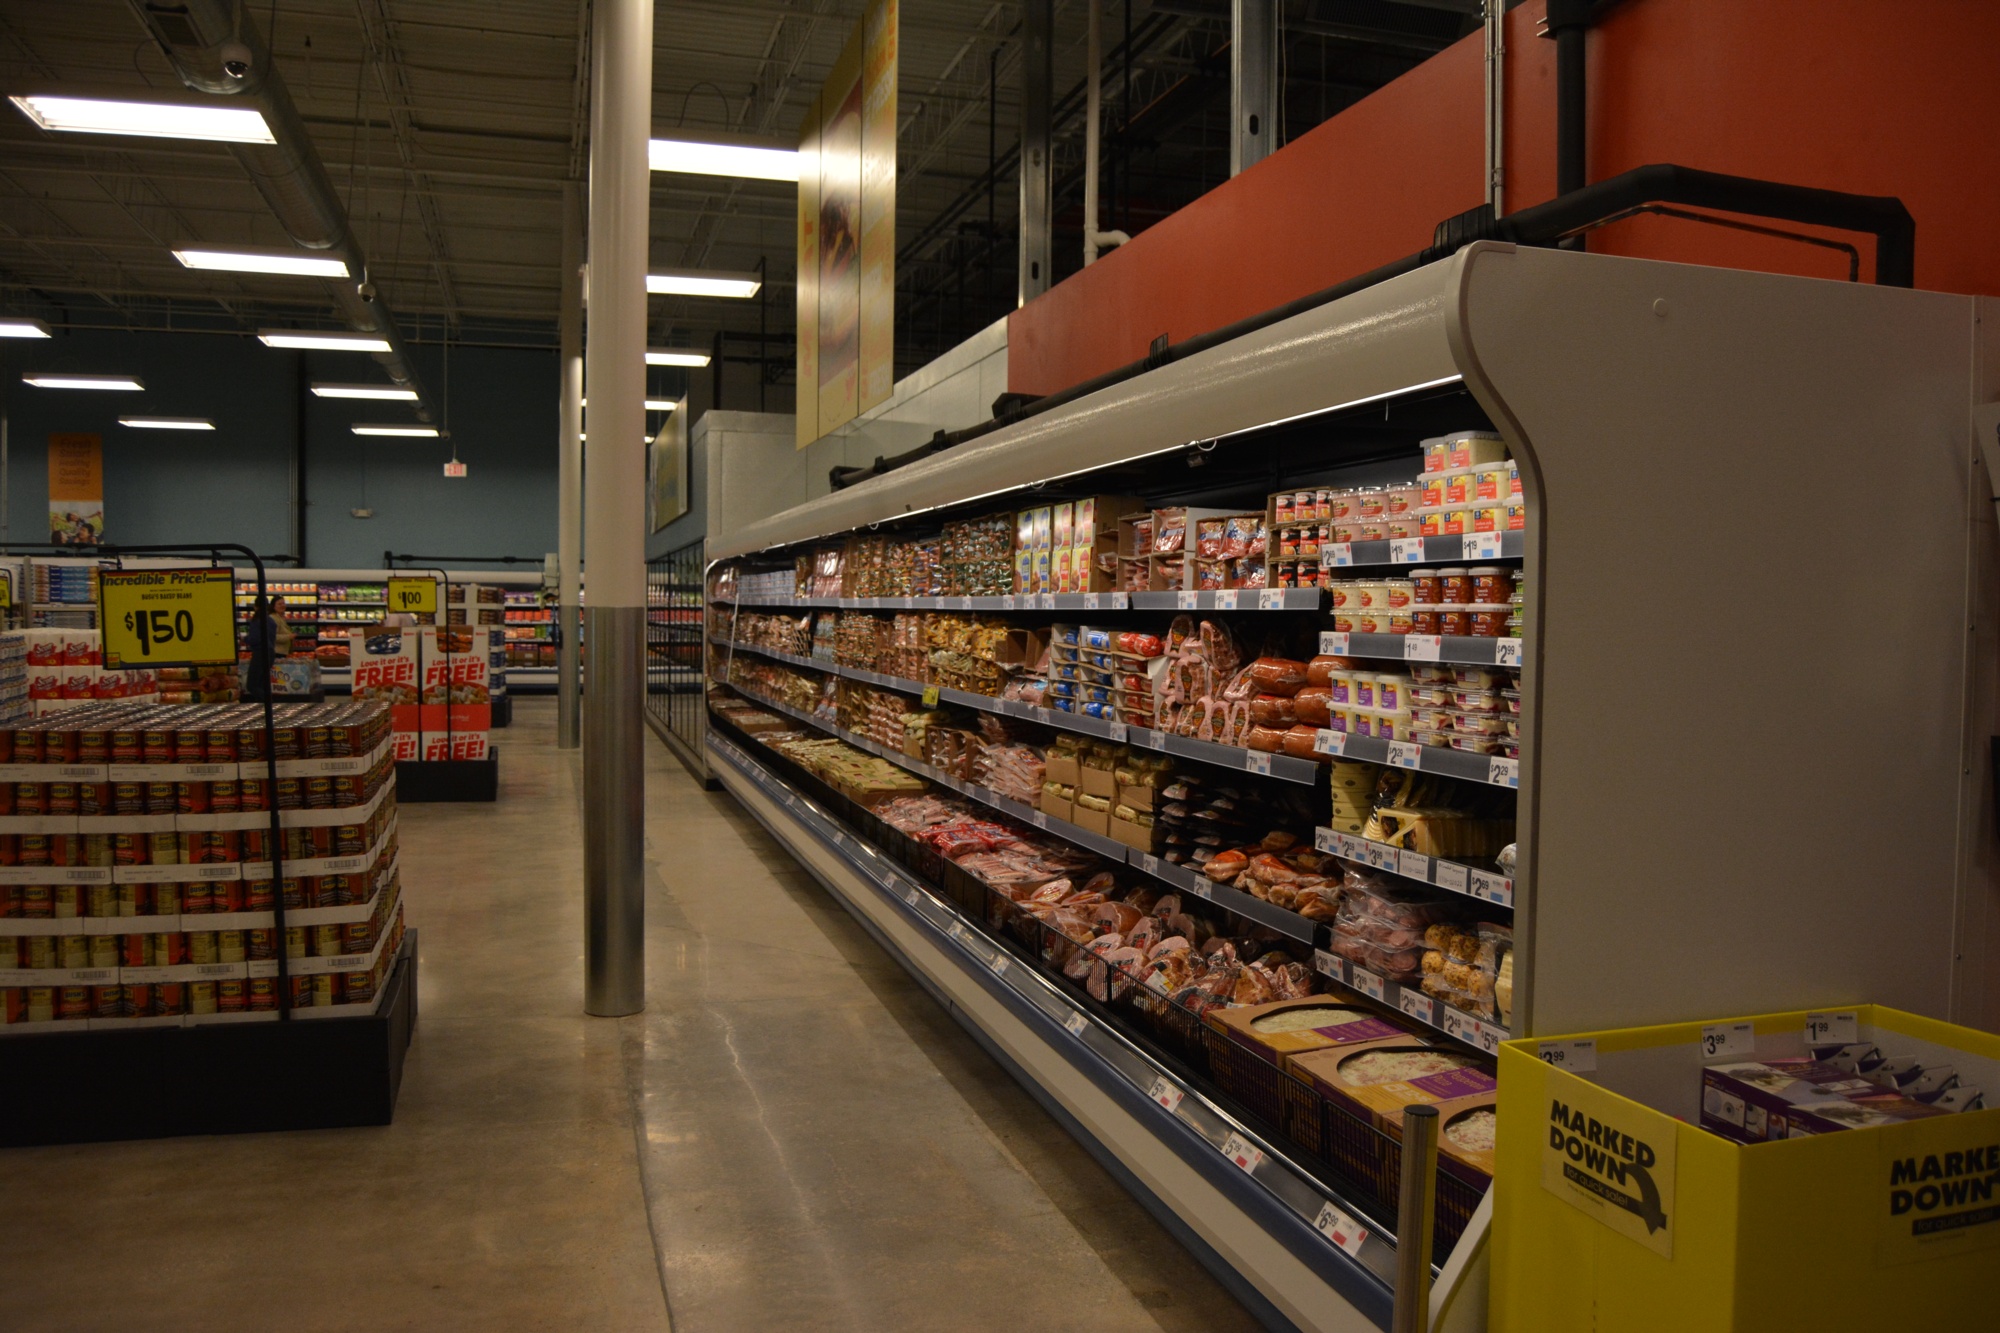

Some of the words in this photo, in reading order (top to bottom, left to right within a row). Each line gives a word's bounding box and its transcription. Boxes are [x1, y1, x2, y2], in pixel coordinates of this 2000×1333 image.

[103, 573, 165, 586] Incredible
[170, 572, 208, 585] Price!
[380, 658, 387, 666] it
[397, 656, 409, 664] it's
[355, 663, 414, 686] FREE!
[426, 663, 485, 685] FREE!
[427, 740, 485, 761] FREE!
[1550, 1099, 1655, 1168] MARKED
[1550, 1124, 1626, 1186] DOWN
[1565, 1164, 1578, 1179] for
[1579, 1174, 1604, 1196] quick
[1605, 1188, 1628, 1206] sale!
[1891, 1177, 1992, 1216] DOWN
[1917, 1219, 1933, 1232] for
[1934, 1213, 1967, 1230] quick
